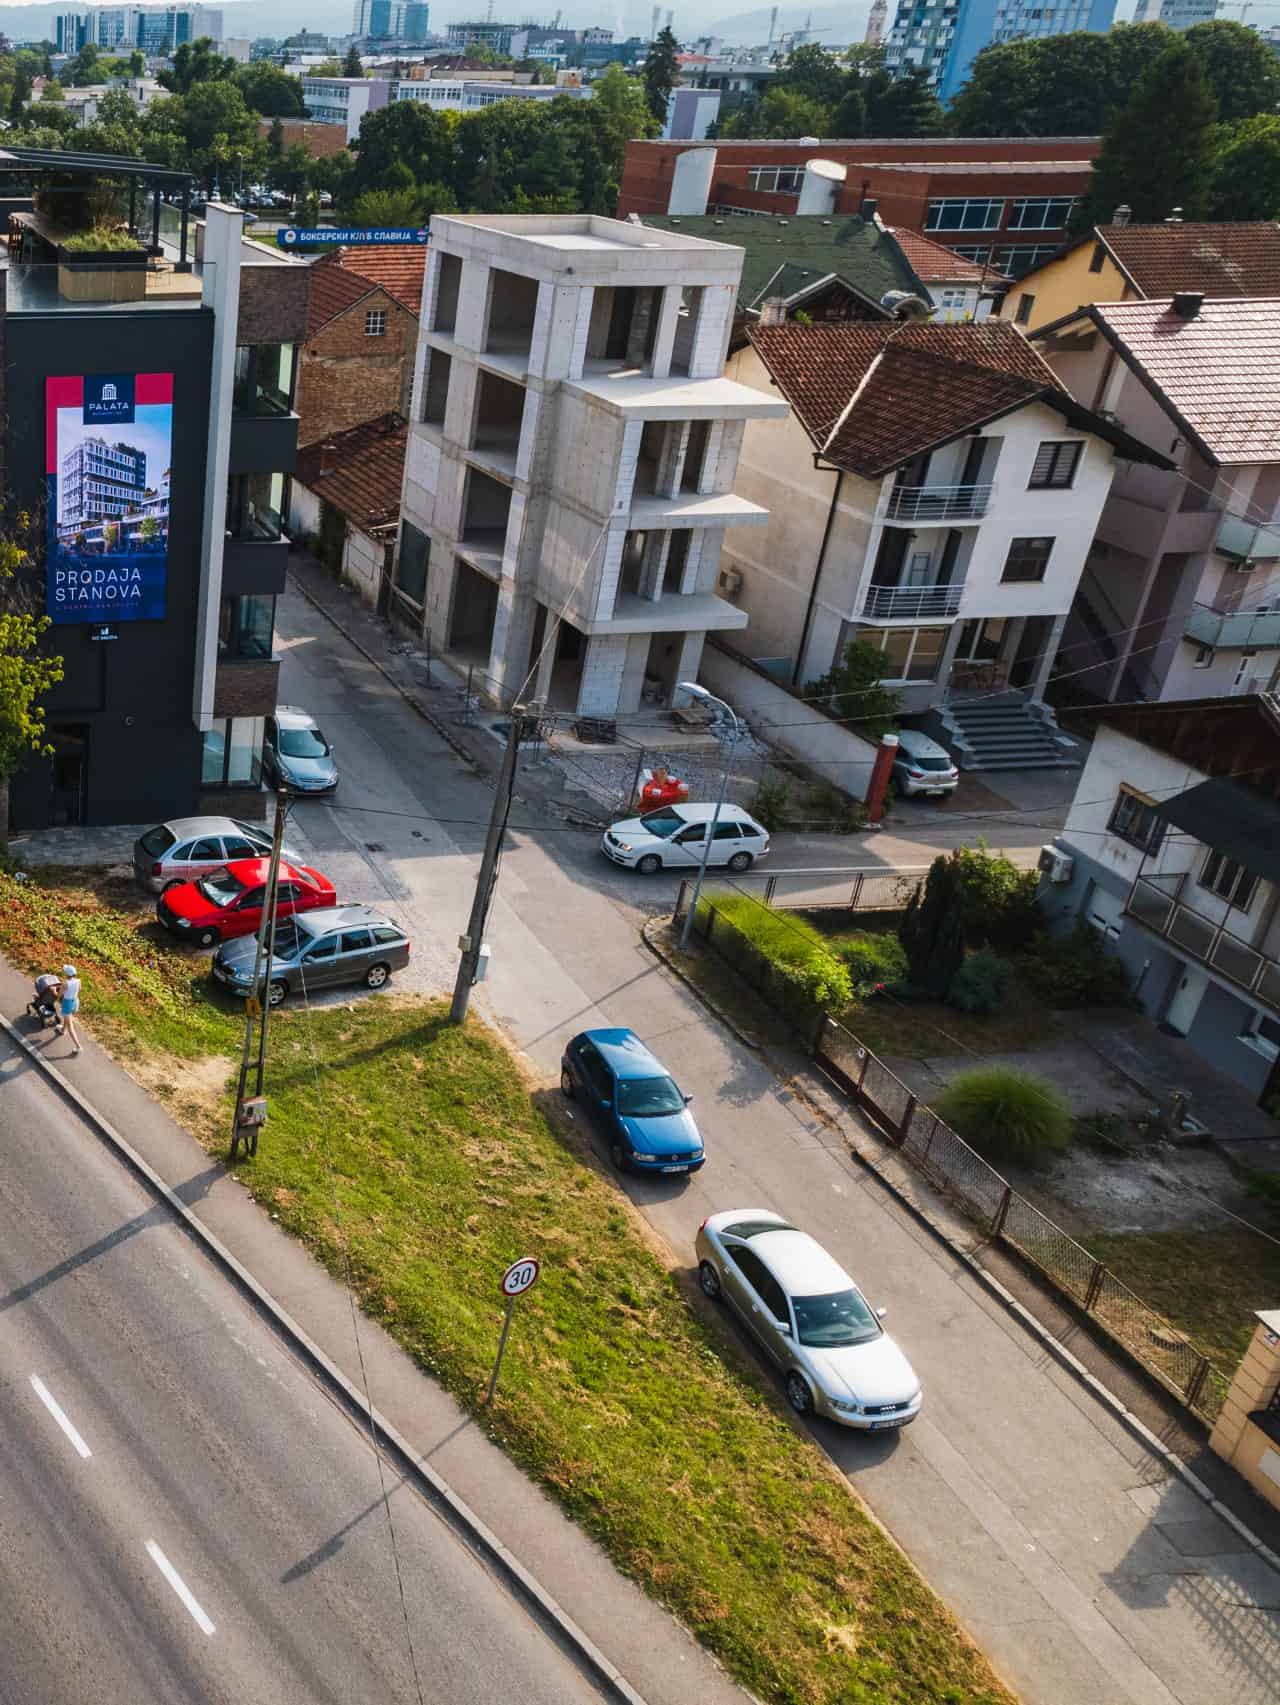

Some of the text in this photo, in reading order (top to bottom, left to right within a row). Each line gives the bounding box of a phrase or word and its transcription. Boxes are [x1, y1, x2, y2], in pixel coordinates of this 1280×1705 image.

[300, 230, 411, 241] БОКСЕРСКИ КЛУБ СЛАВИЈА
[89, 401, 129, 411] PALATA
[56, 567, 142, 585] PRODAJA
[55, 584, 142, 602] STANOVA
[509, 1267, 532, 1289] 30
